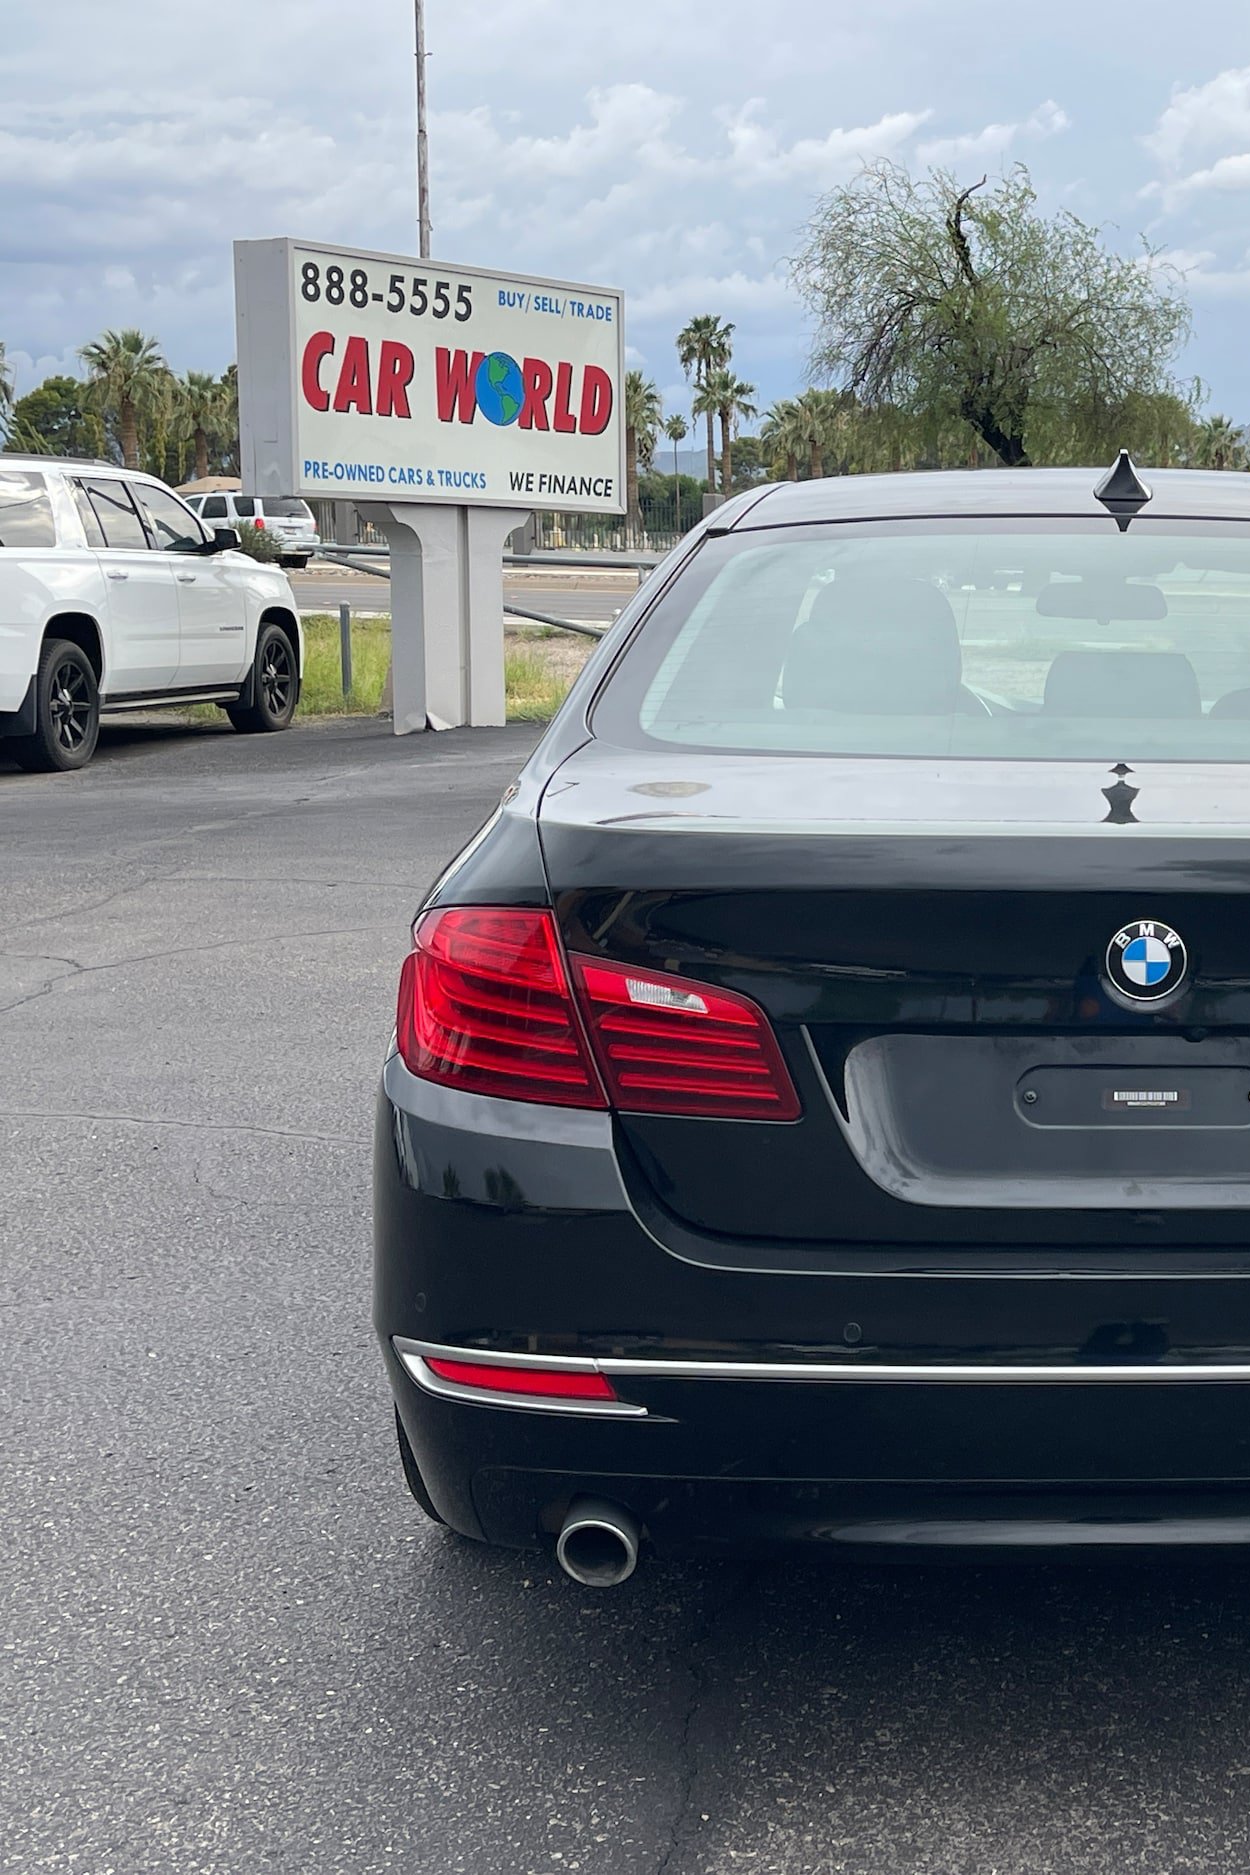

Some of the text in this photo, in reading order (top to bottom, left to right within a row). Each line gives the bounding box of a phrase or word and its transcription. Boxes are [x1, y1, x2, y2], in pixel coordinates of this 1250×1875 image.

[301, 261, 472, 322] 888-5555
[570, 300, 612, 322] TRADE
[301, 330, 415, 419] CAR
[304, 460, 487, 490] PRE-OWNED CARS & TRUCKS
[509, 471, 613, 498] WE FINANCE
[1114, 923, 1180, 949] BMW
